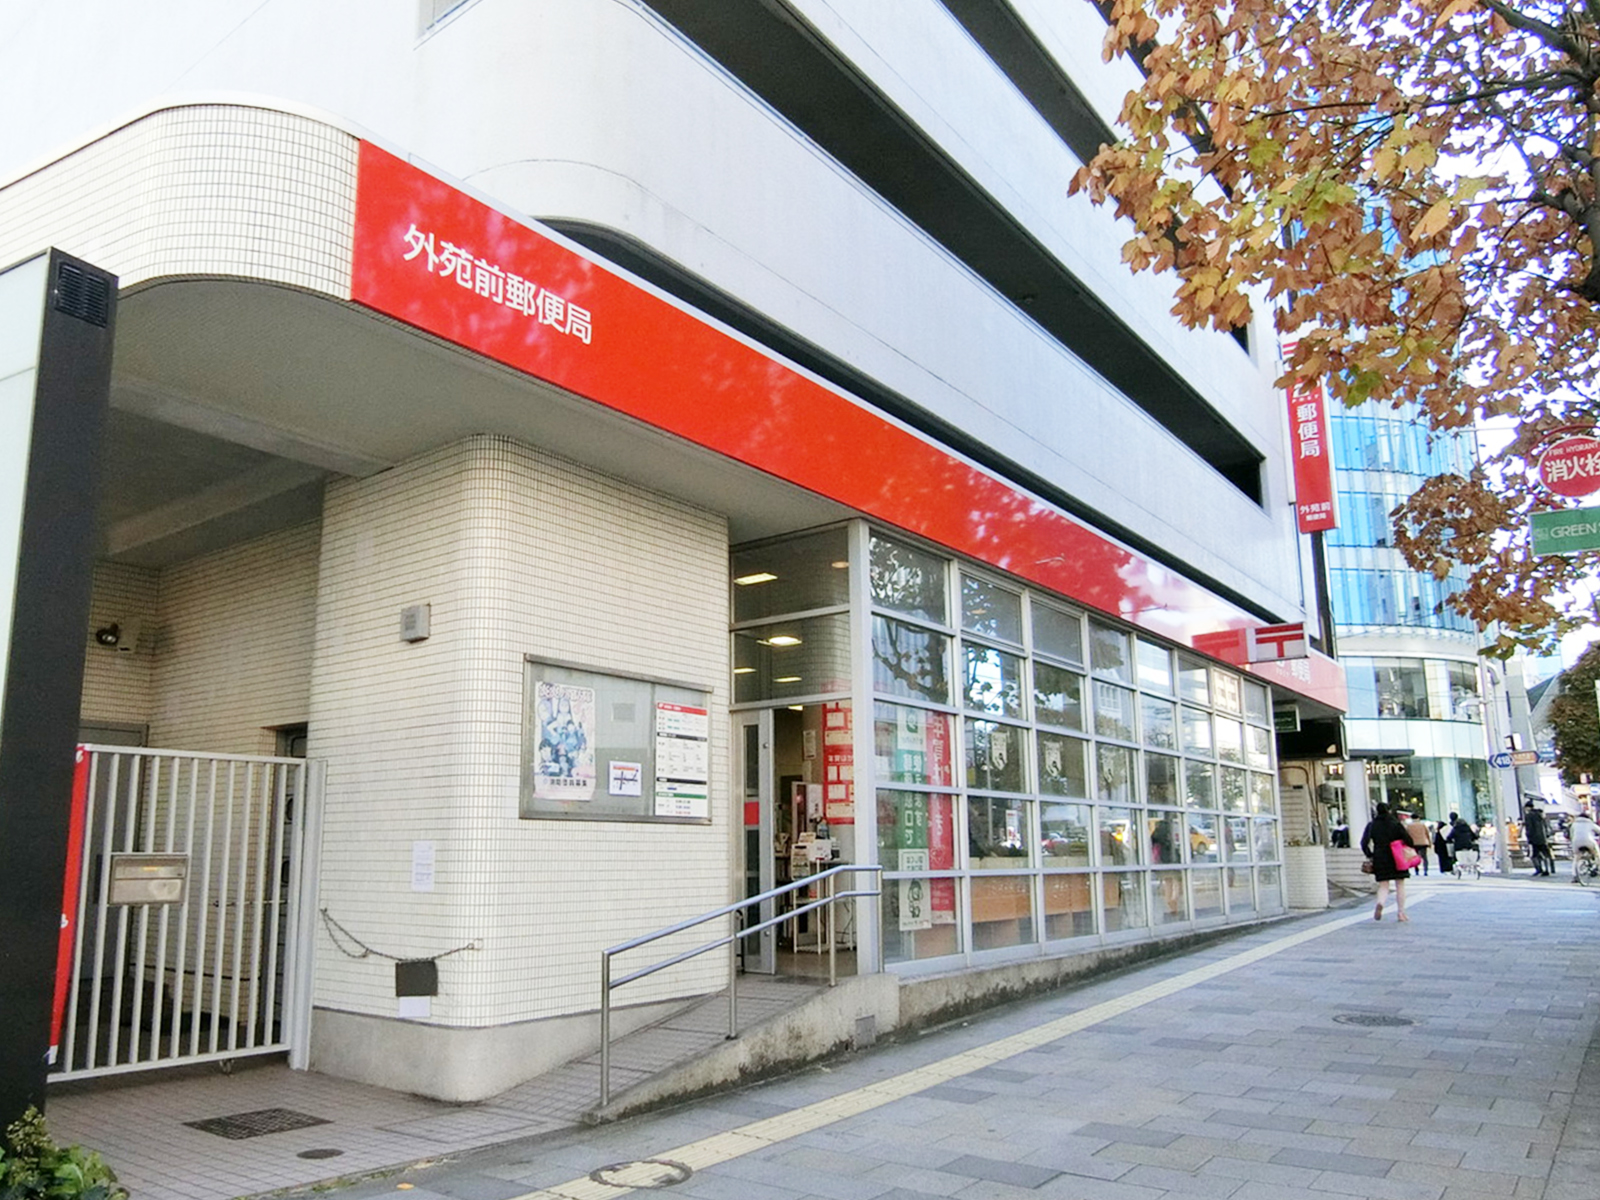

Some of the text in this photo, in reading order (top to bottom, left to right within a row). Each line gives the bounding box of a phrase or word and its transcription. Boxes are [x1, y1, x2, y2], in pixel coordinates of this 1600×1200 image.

[403, 223, 593, 345] 外苑前郵便局
[1296, 403, 1321, 460] 郵便局
[1548, 442, 1599, 457] FIRE HYDRANT
[1550, 522, 1597, 539] GREEN
[1328, 761, 1406, 775] Frcfranc
